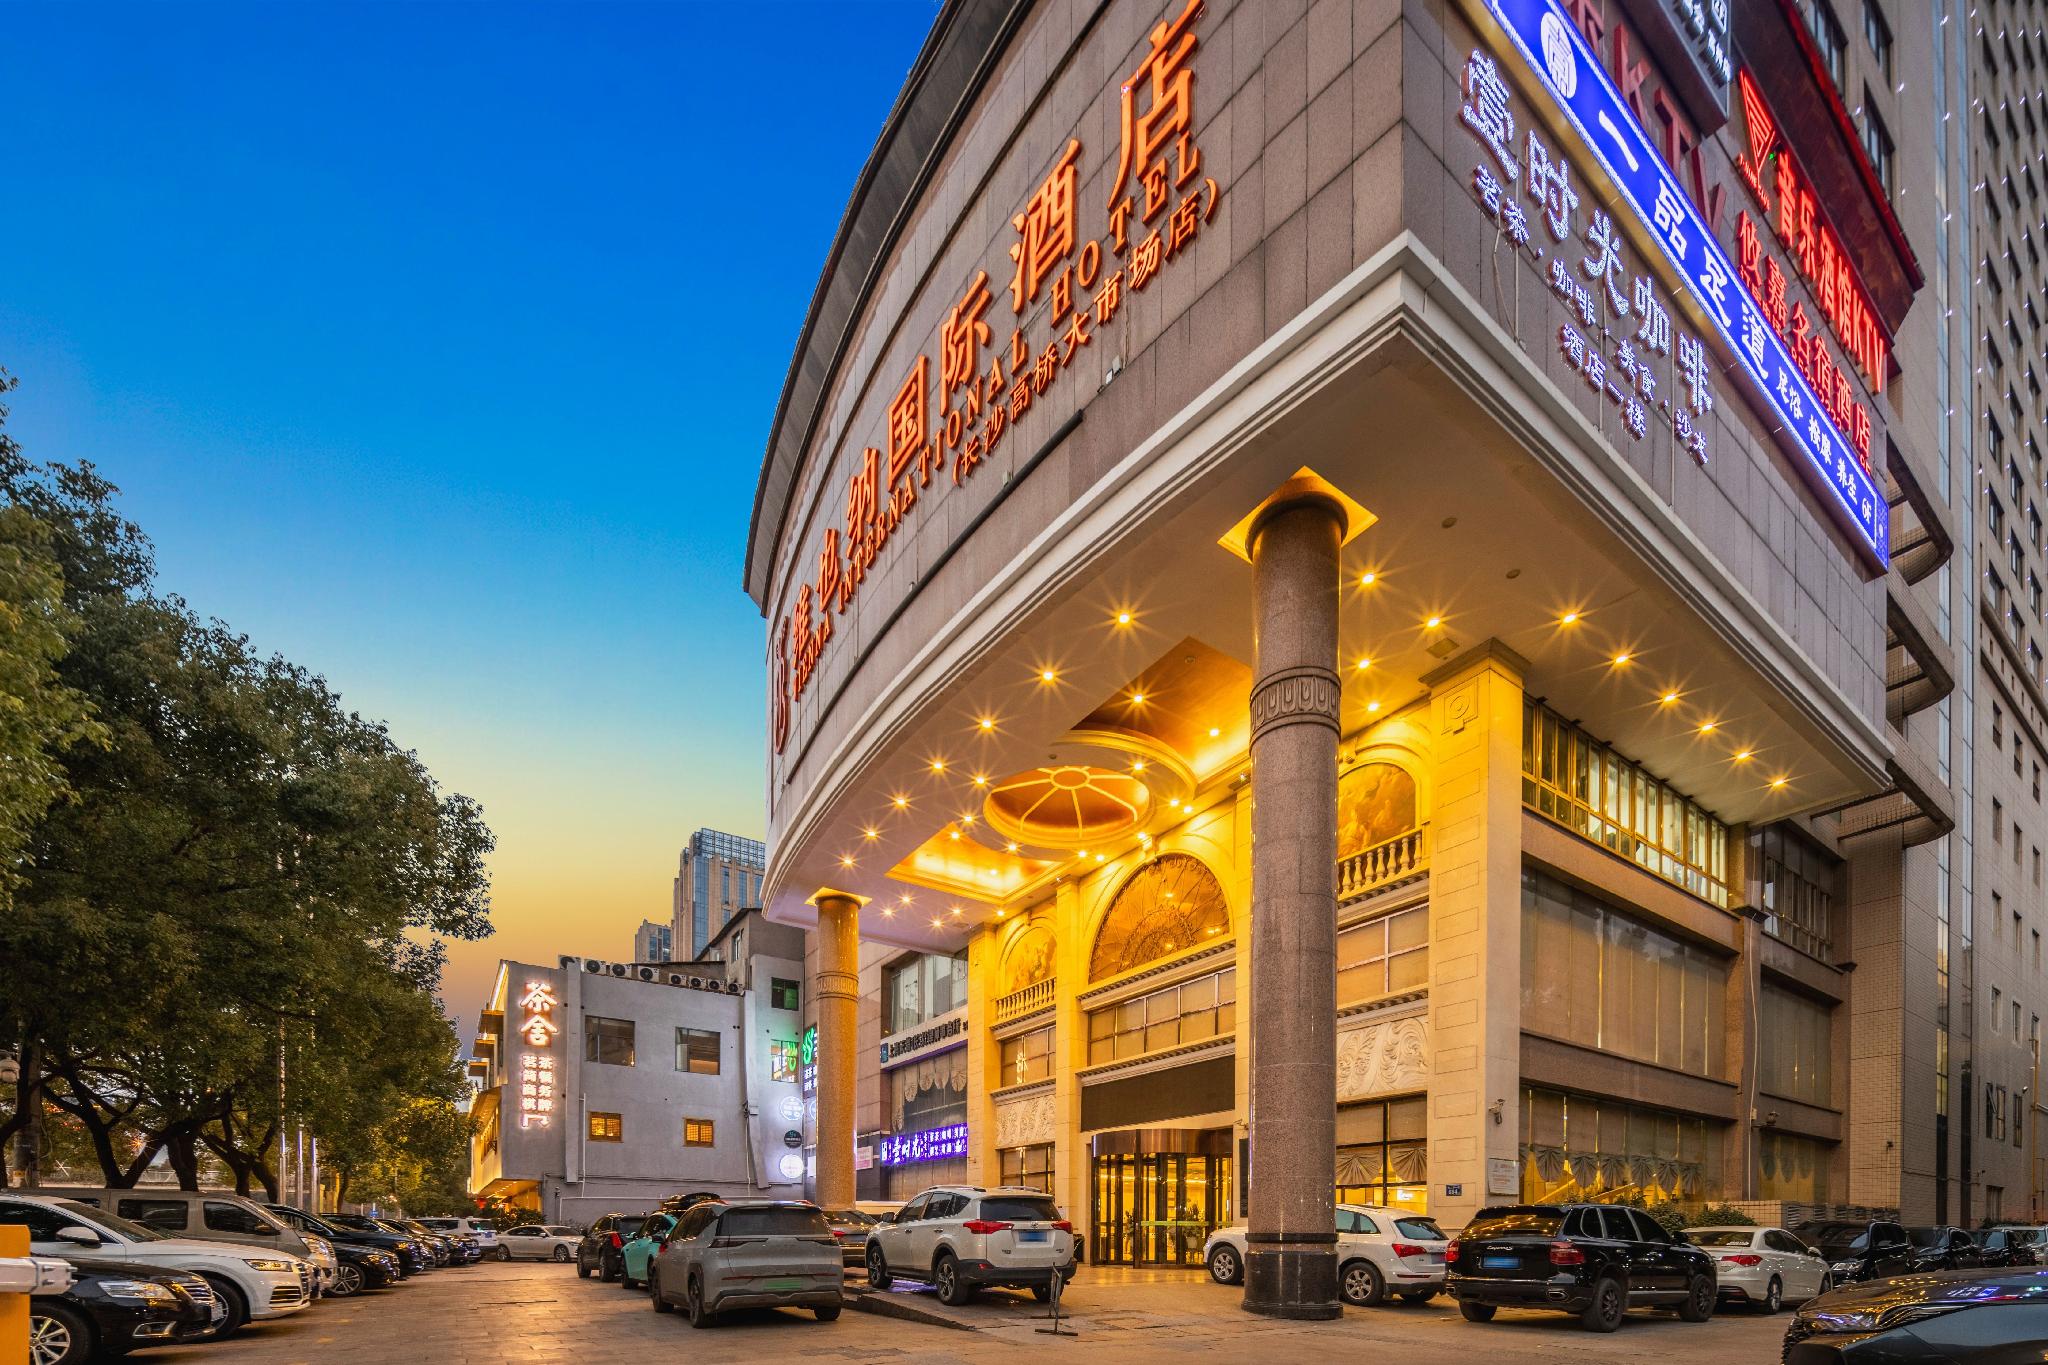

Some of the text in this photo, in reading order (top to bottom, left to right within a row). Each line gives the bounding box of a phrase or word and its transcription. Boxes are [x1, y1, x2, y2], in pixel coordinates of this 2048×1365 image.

[792, 0, 1203, 670] 维也纳国际酒店
[837, 329, 1028, 614] INTERNATIONAL
[1051, 131, 1201, 328] HOTEL
[1599, 110, 1768, 380] 一品足道
